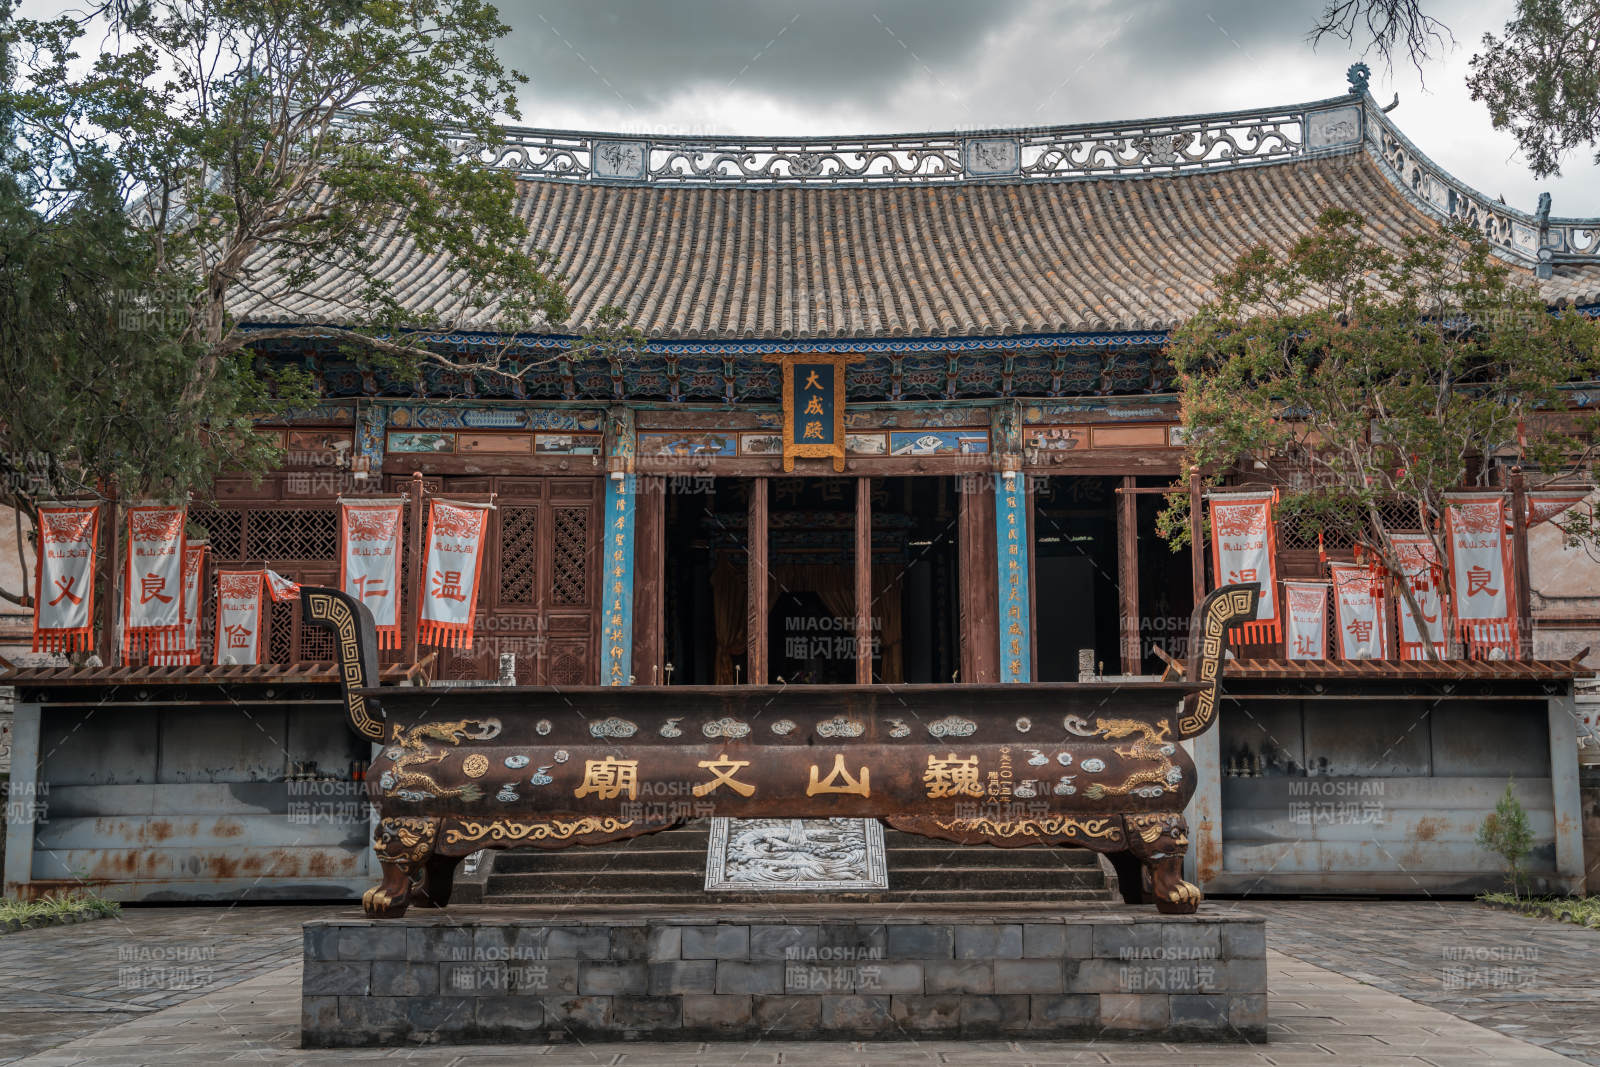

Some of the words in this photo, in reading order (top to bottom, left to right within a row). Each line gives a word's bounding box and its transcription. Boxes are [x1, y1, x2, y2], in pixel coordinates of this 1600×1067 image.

[803, 370, 824, 440] 大成殿
[47, 550, 88, 559] 巍山文庙
[136, 546, 176, 558] 巍山文庙
[352, 547, 392, 557] 巍山文庙
[434, 541, 473, 554] 巍山文庙
[48, 576, 82, 606] 义
[140, 573, 173, 604] 良
[352, 574, 389, 601] 仁
[431, 570, 467, 602] 温
[1467, 565, 1499, 597] 良
[224, 624, 252, 649] 俭
[1346, 618, 1373, 643] 智
[1293, 634, 1318, 657] 让
